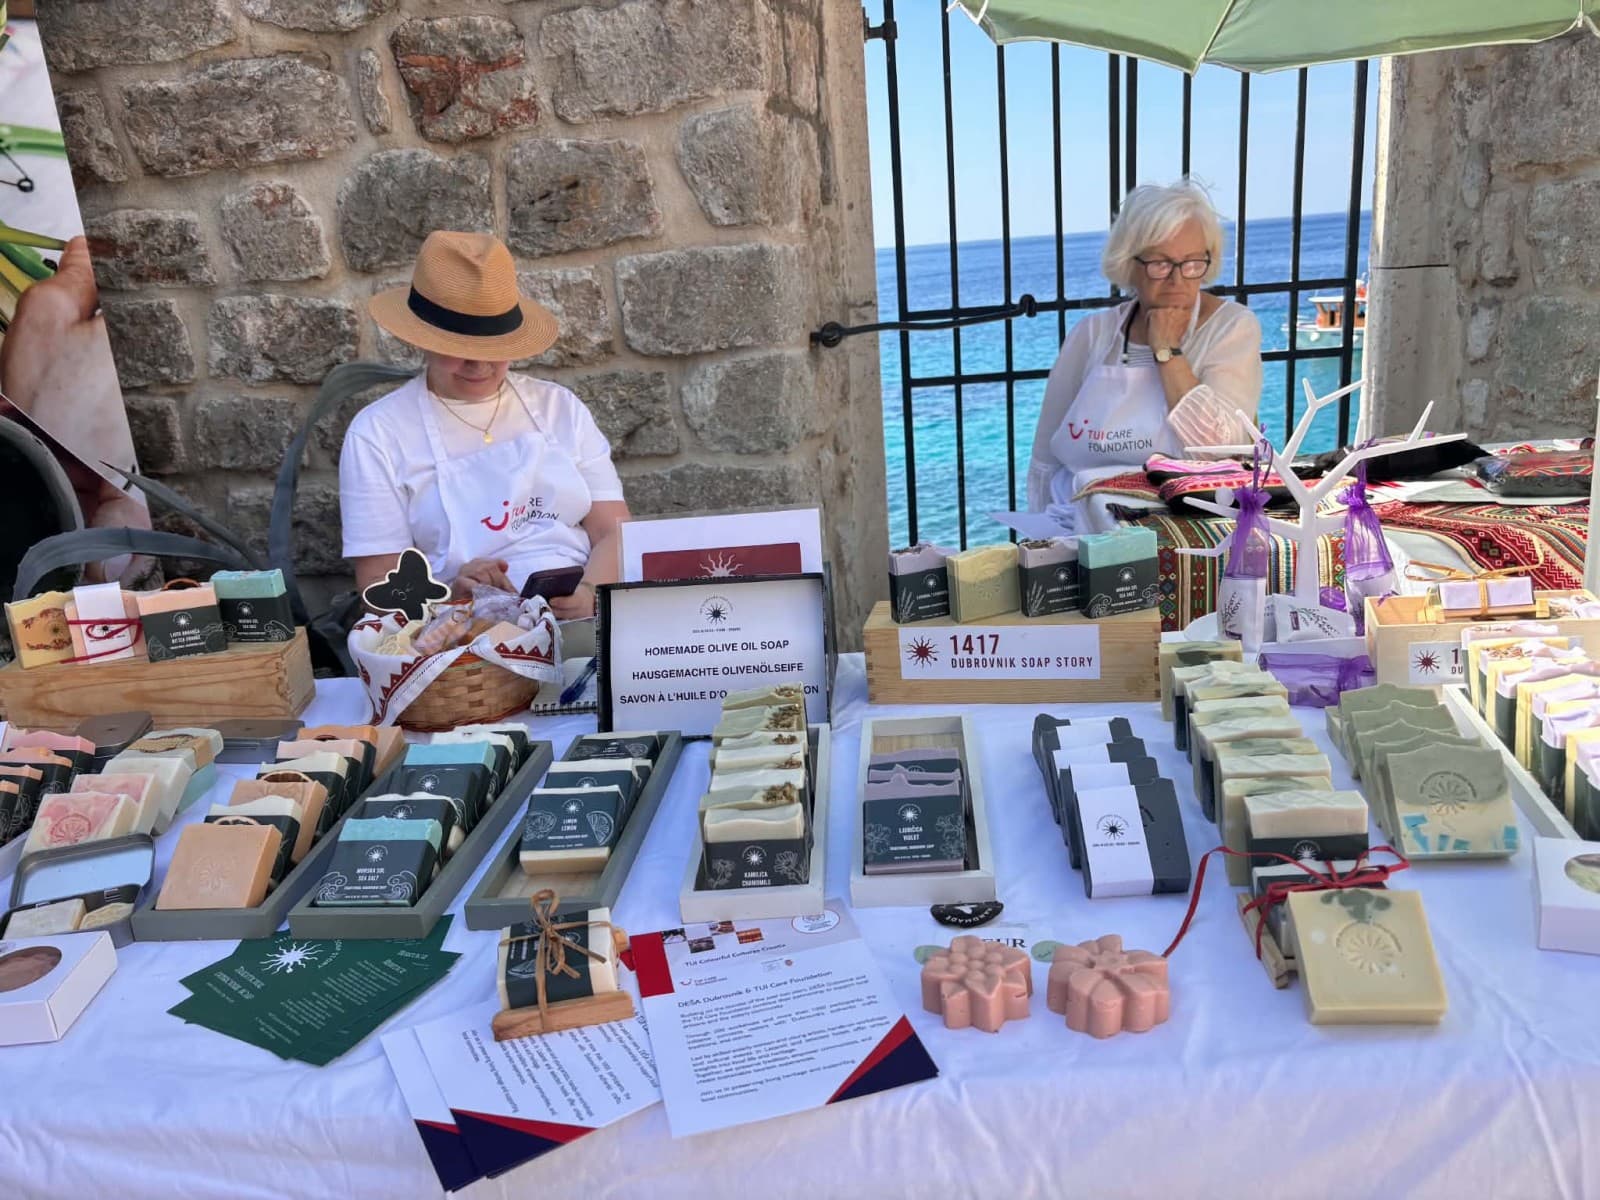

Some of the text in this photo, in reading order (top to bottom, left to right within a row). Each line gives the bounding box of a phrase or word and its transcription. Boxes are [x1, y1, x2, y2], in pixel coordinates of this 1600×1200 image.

[1088, 429, 1133, 440] TUI CARE
[1088, 439, 1153, 453] FOUNDATION
[644, 640, 789, 656] HOMEMADE OLIVE OIL SOAP
[949, 634, 1000, 656] 1417
[951, 656, 1093, 669] DUBROVNIK SOAP STORY
[632, 661, 804, 681] HAUSGEMACHTE OLIVENÖLSEIFE
[619, 694, 656, 705] SAVON
[657, 691, 666, 702] À
[667, 690, 707, 702] L'HUILE
[769, 980, 787, 988] Care
[790, 970, 832, 984] Foundation
